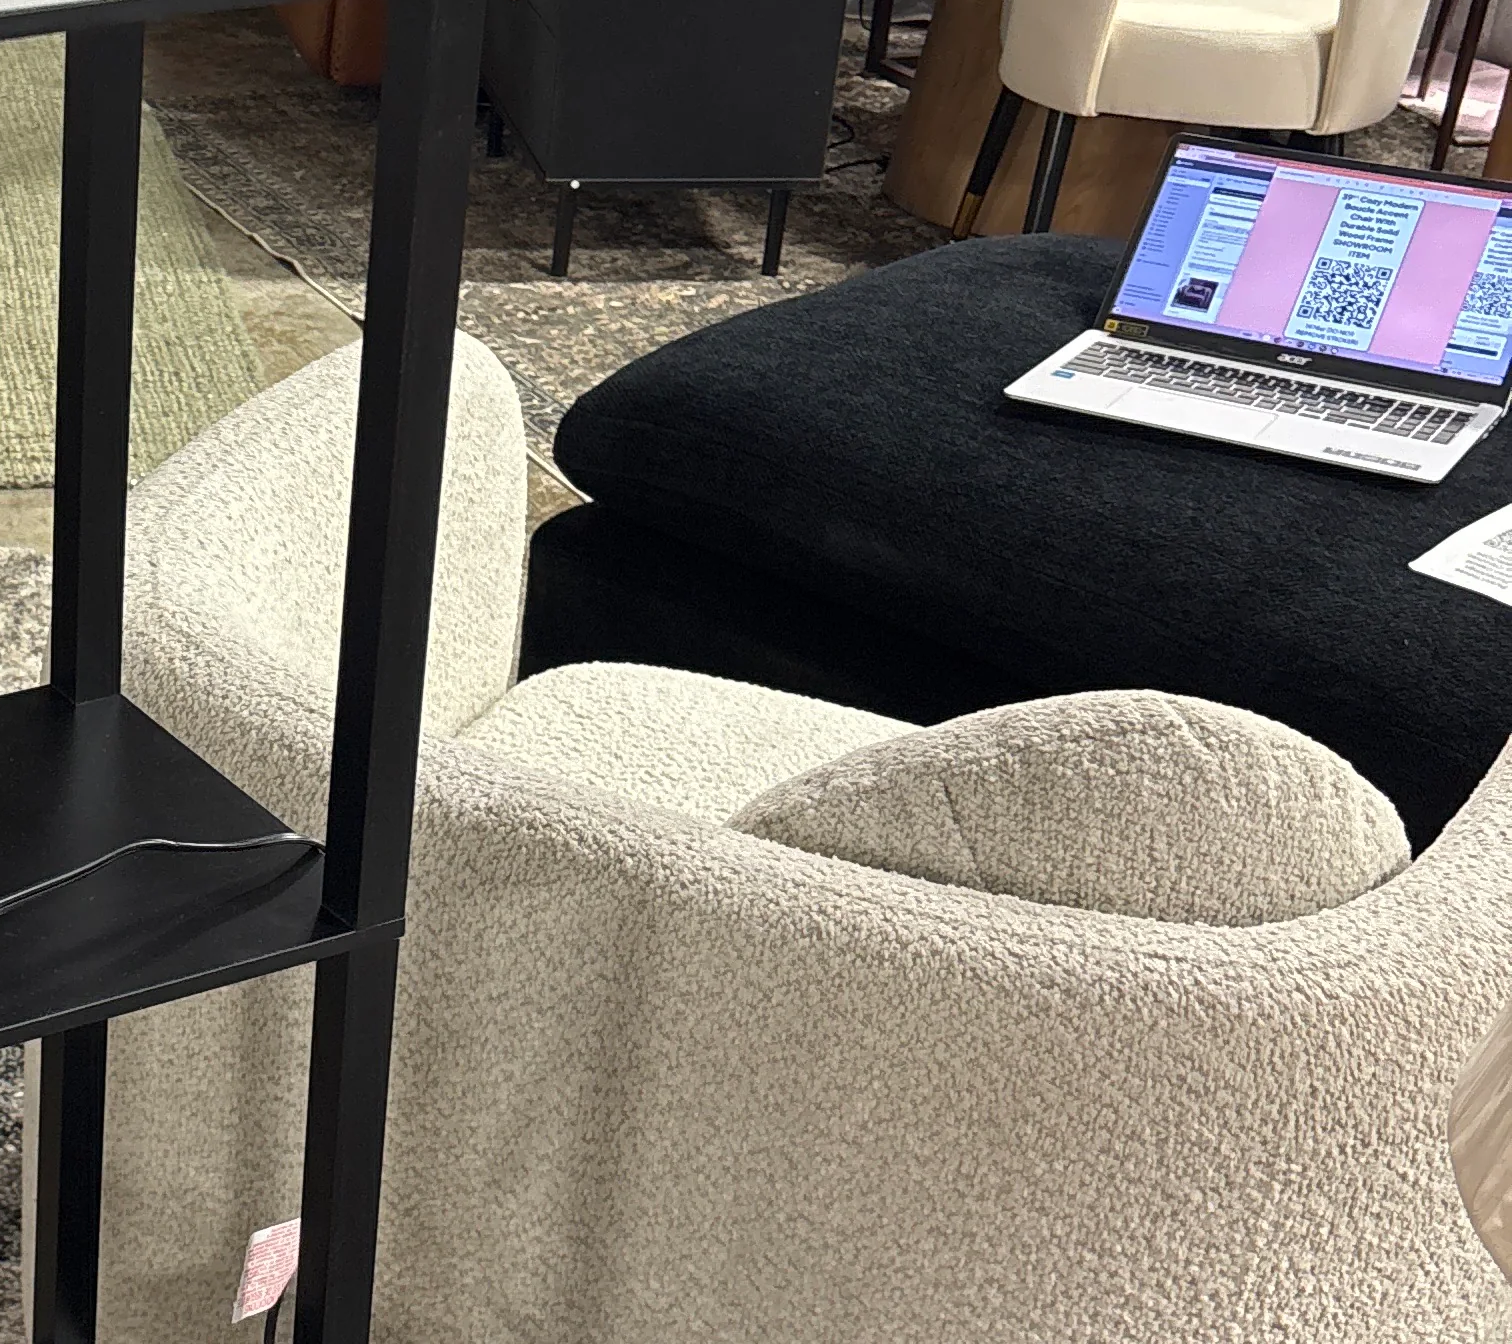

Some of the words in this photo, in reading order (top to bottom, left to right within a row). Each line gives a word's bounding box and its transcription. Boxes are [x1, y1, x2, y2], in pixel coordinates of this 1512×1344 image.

[1360, 196, 1383, 206] Cozy
[1383, 199, 1419, 211] Modern
[1344, 203, 1375, 214] Boucle
[1376, 208, 1409, 219] Accent
[1340, 221, 1375, 232] Durable
[1350, 213, 1374, 222] Chair
[1375, 217, 1396, 226] With
[1338, 230, 1366, 241] Wood
[1366, 235, 1395, 245] Frame
[1333, 238, 1393, 254] SHOWROOM
[1348, 251, 1371, 260] ITEM
[1277, 353, 1312, 366] acer
